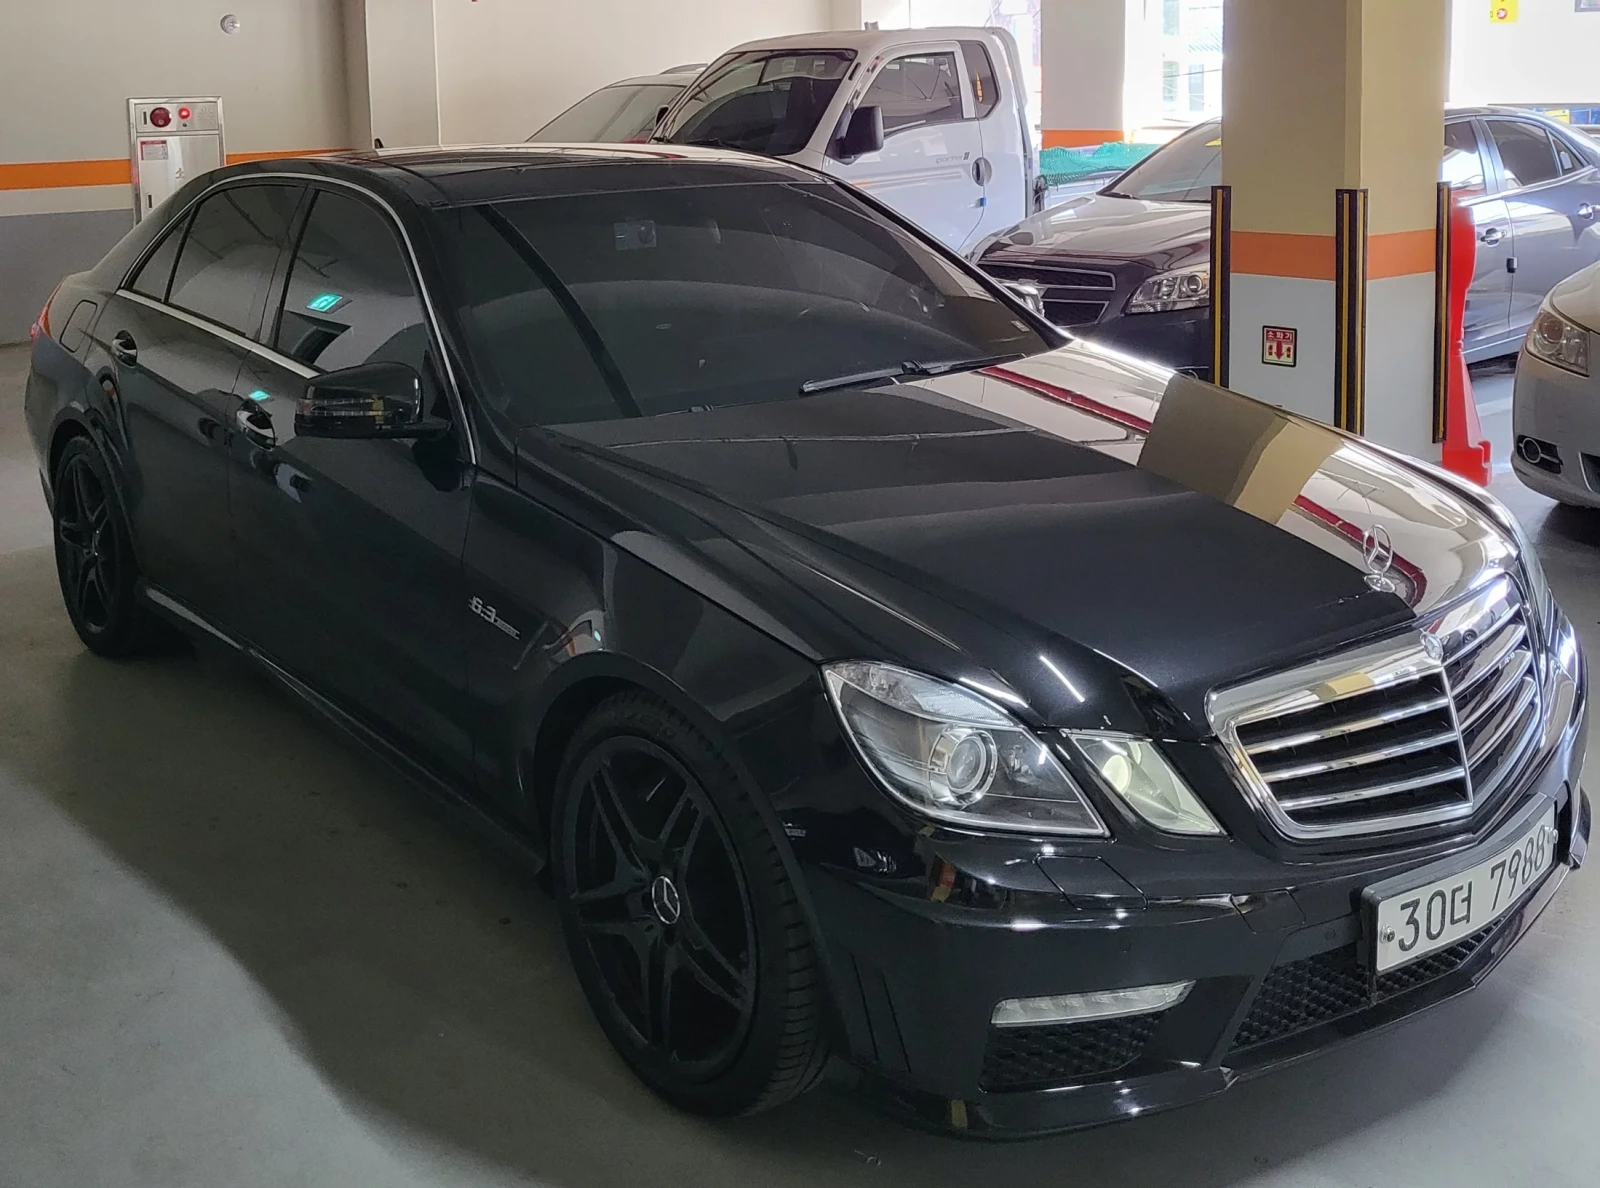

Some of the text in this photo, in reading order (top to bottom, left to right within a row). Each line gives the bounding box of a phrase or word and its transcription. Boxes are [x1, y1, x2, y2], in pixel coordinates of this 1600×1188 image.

[1267, 330, 1293, 341] 소화기
[1398, 824, 1546, 951] 30더 7988
